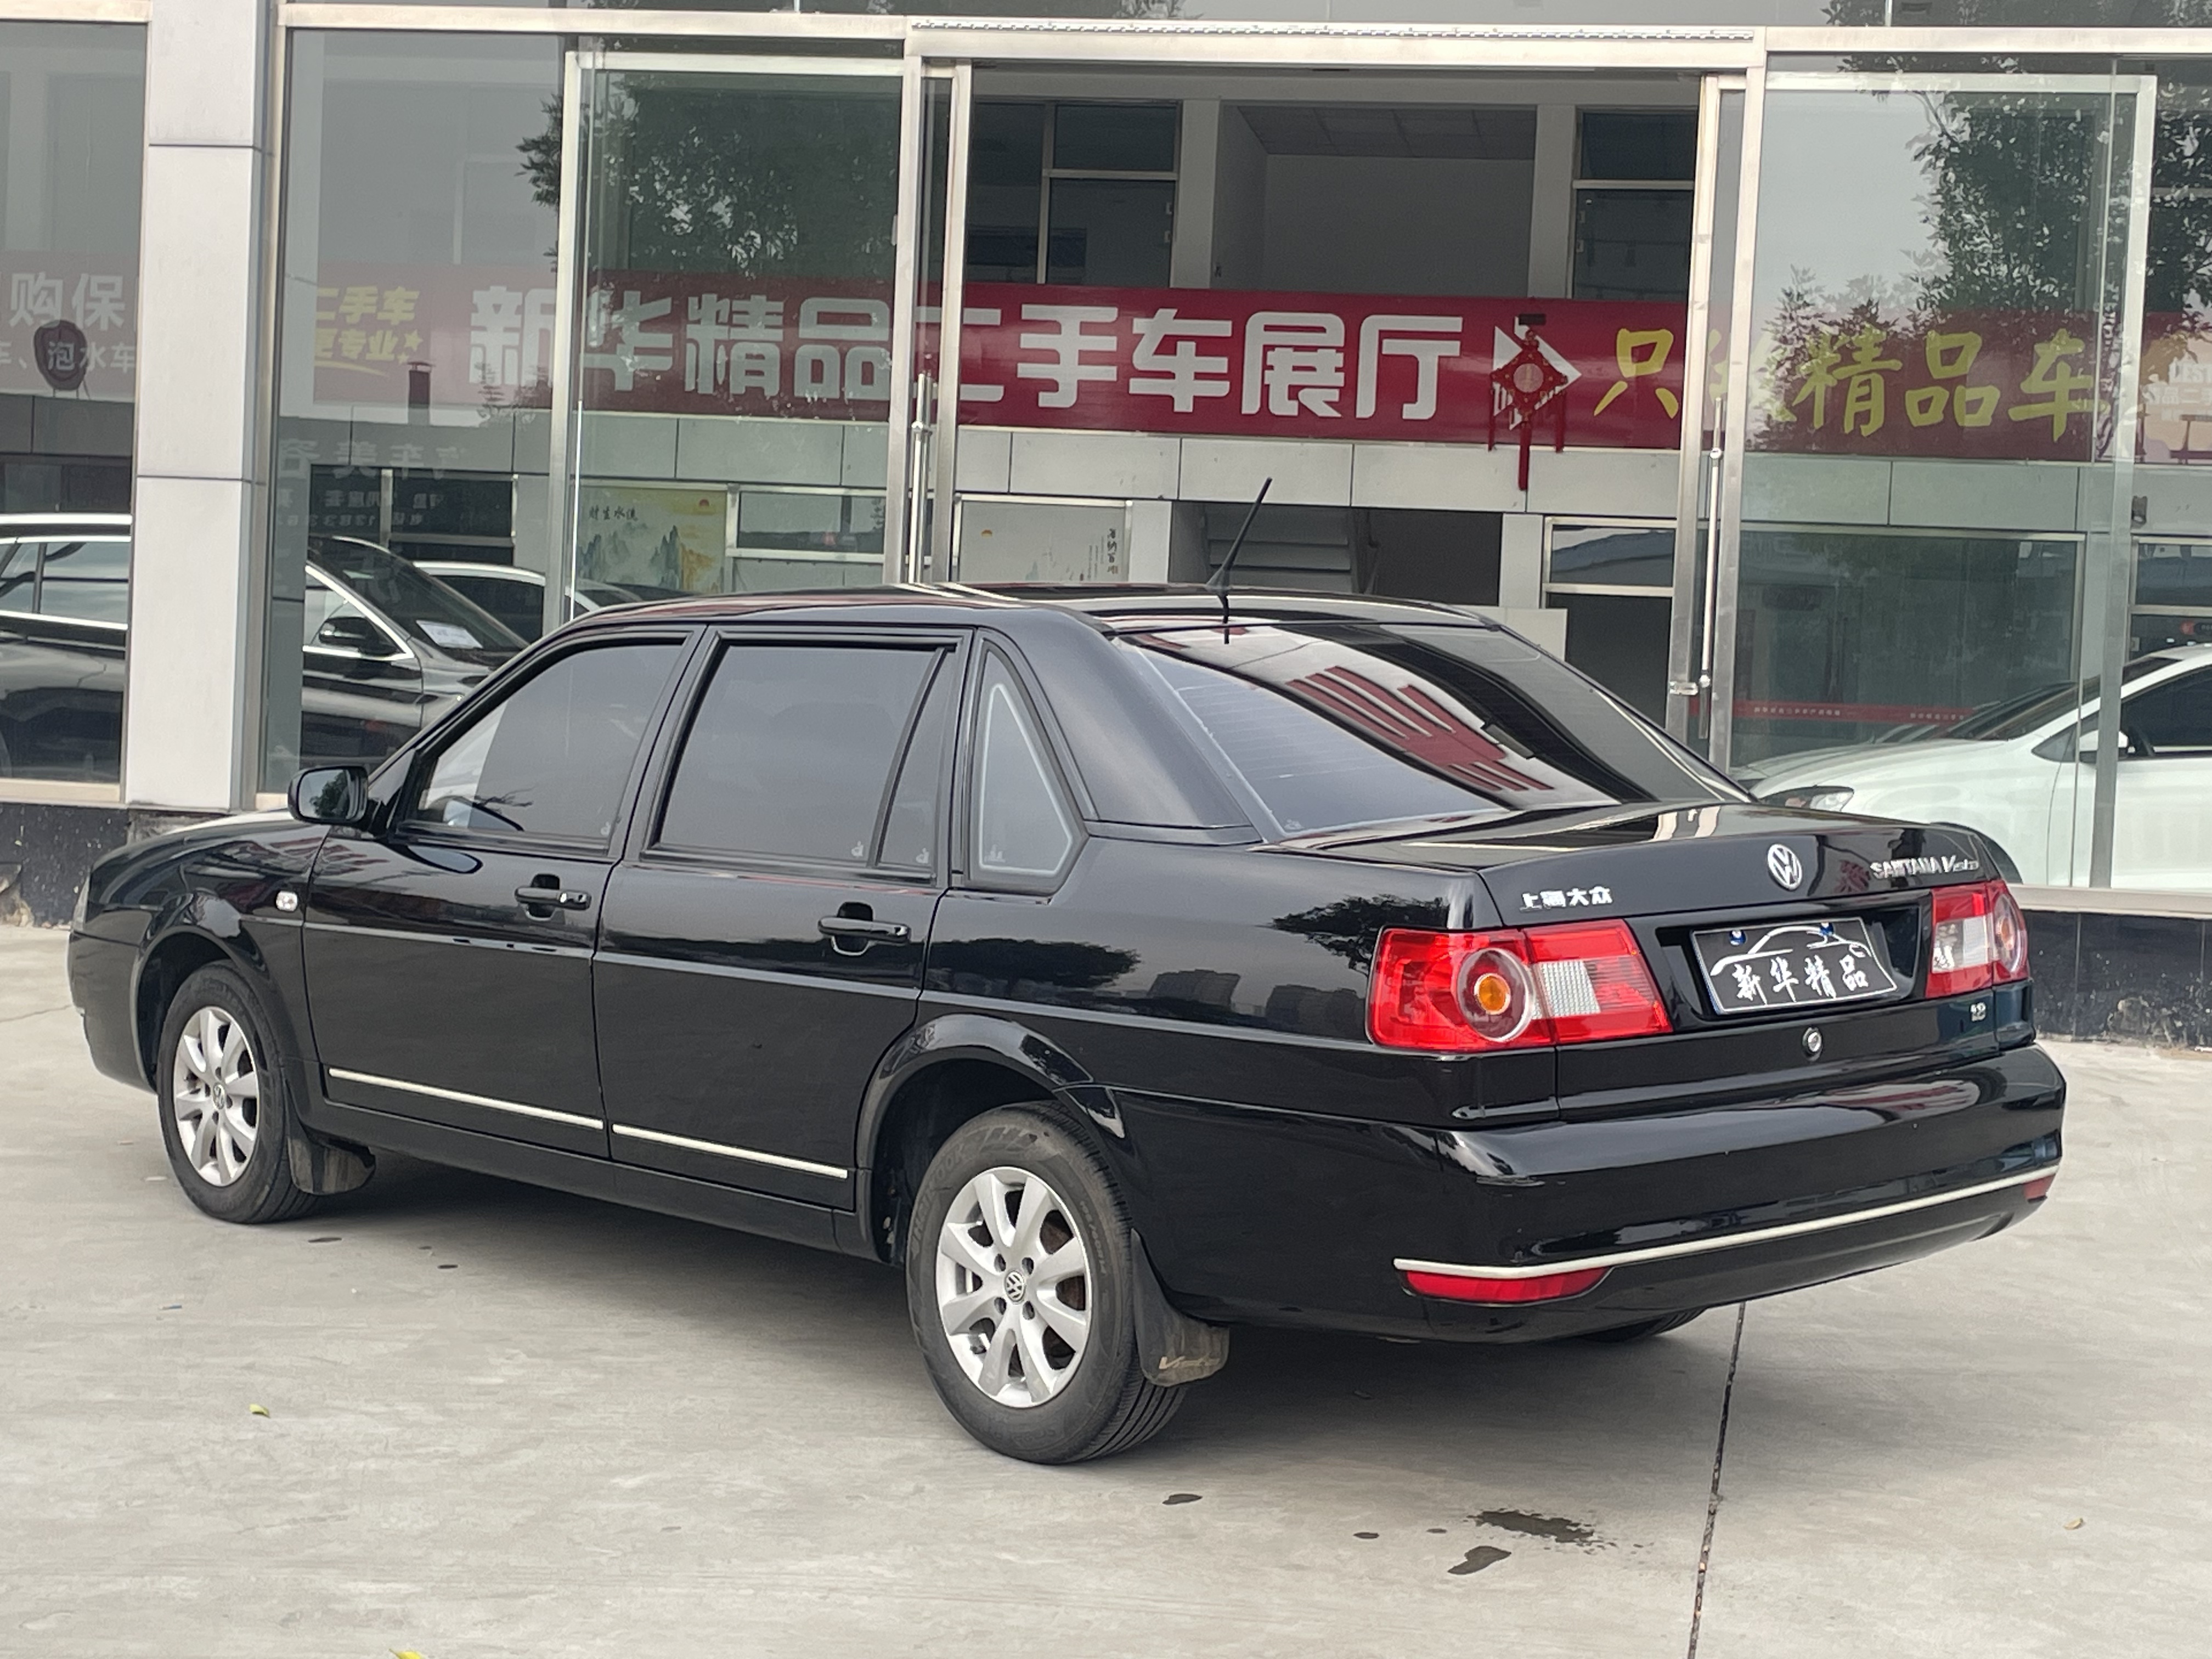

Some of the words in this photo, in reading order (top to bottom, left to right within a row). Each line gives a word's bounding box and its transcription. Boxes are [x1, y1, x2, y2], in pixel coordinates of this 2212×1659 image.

[1519, 885, 1613, 913] 上海大众
[1732, 955, 1869, 1005] 新华精品
